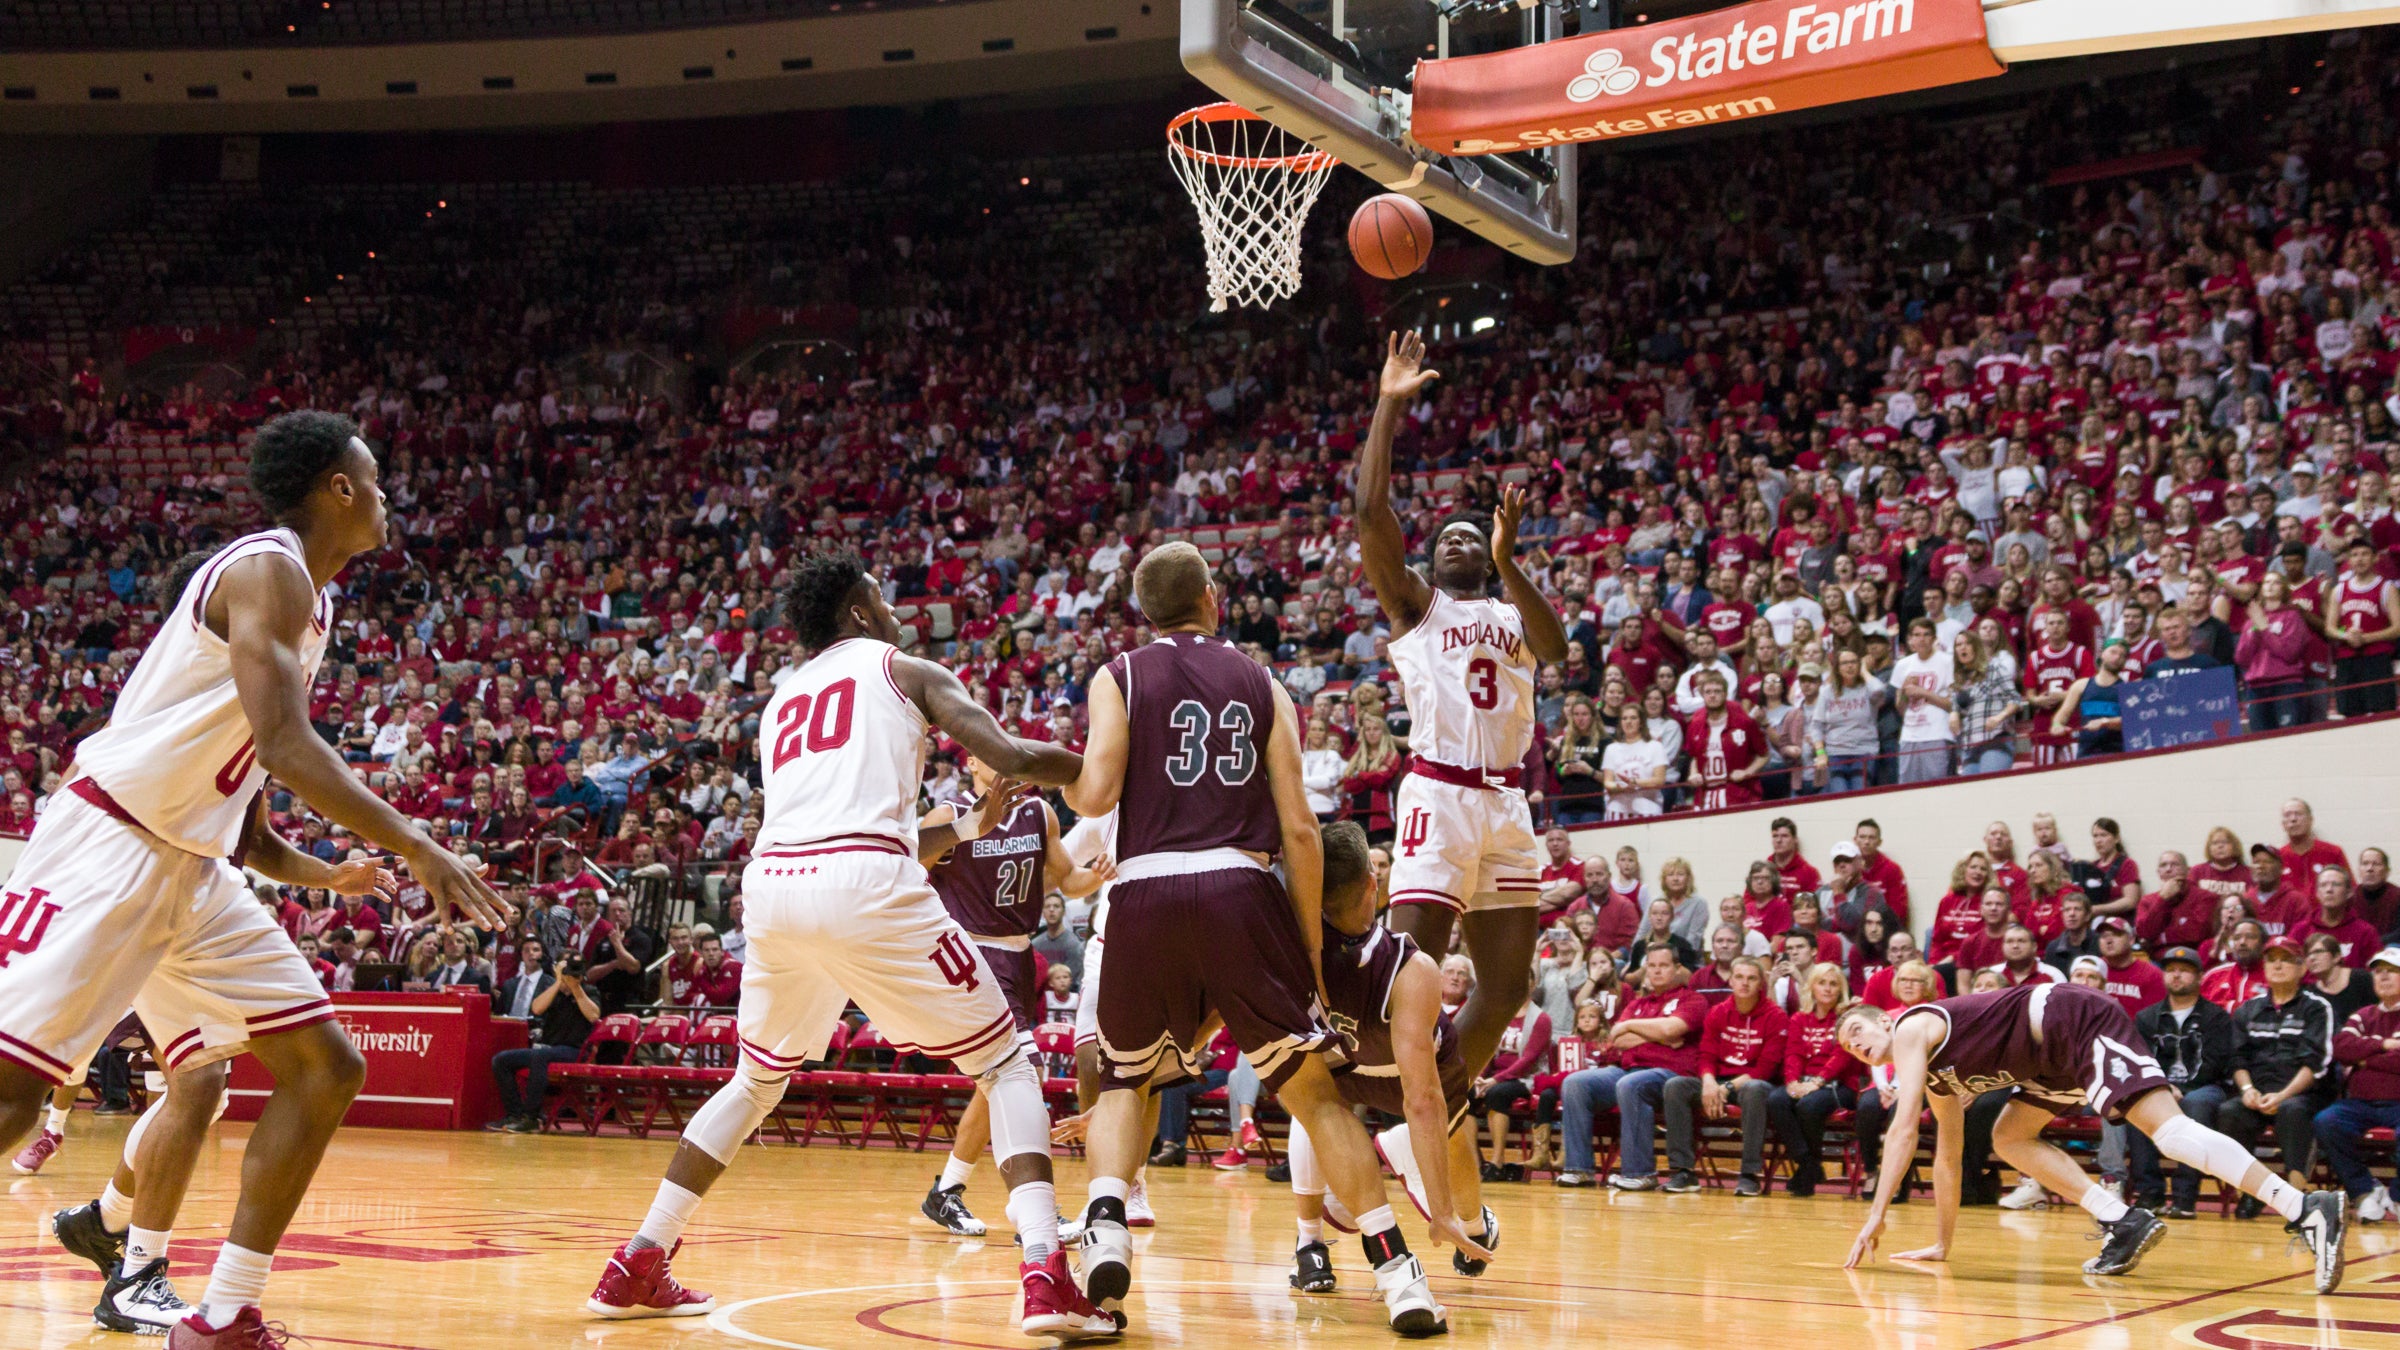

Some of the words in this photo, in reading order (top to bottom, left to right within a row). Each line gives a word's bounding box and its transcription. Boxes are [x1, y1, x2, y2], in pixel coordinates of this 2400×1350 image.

[1469, 657, 1498, 711] 3
[772, 676, 857, 775] 20
[1165, 699, 1258, 787] 33
[972, 833, 1042, 858] BELLARMIN
[995, 857, 1035, 908] 21
[2104, 982, 2142, 999] DIANA
